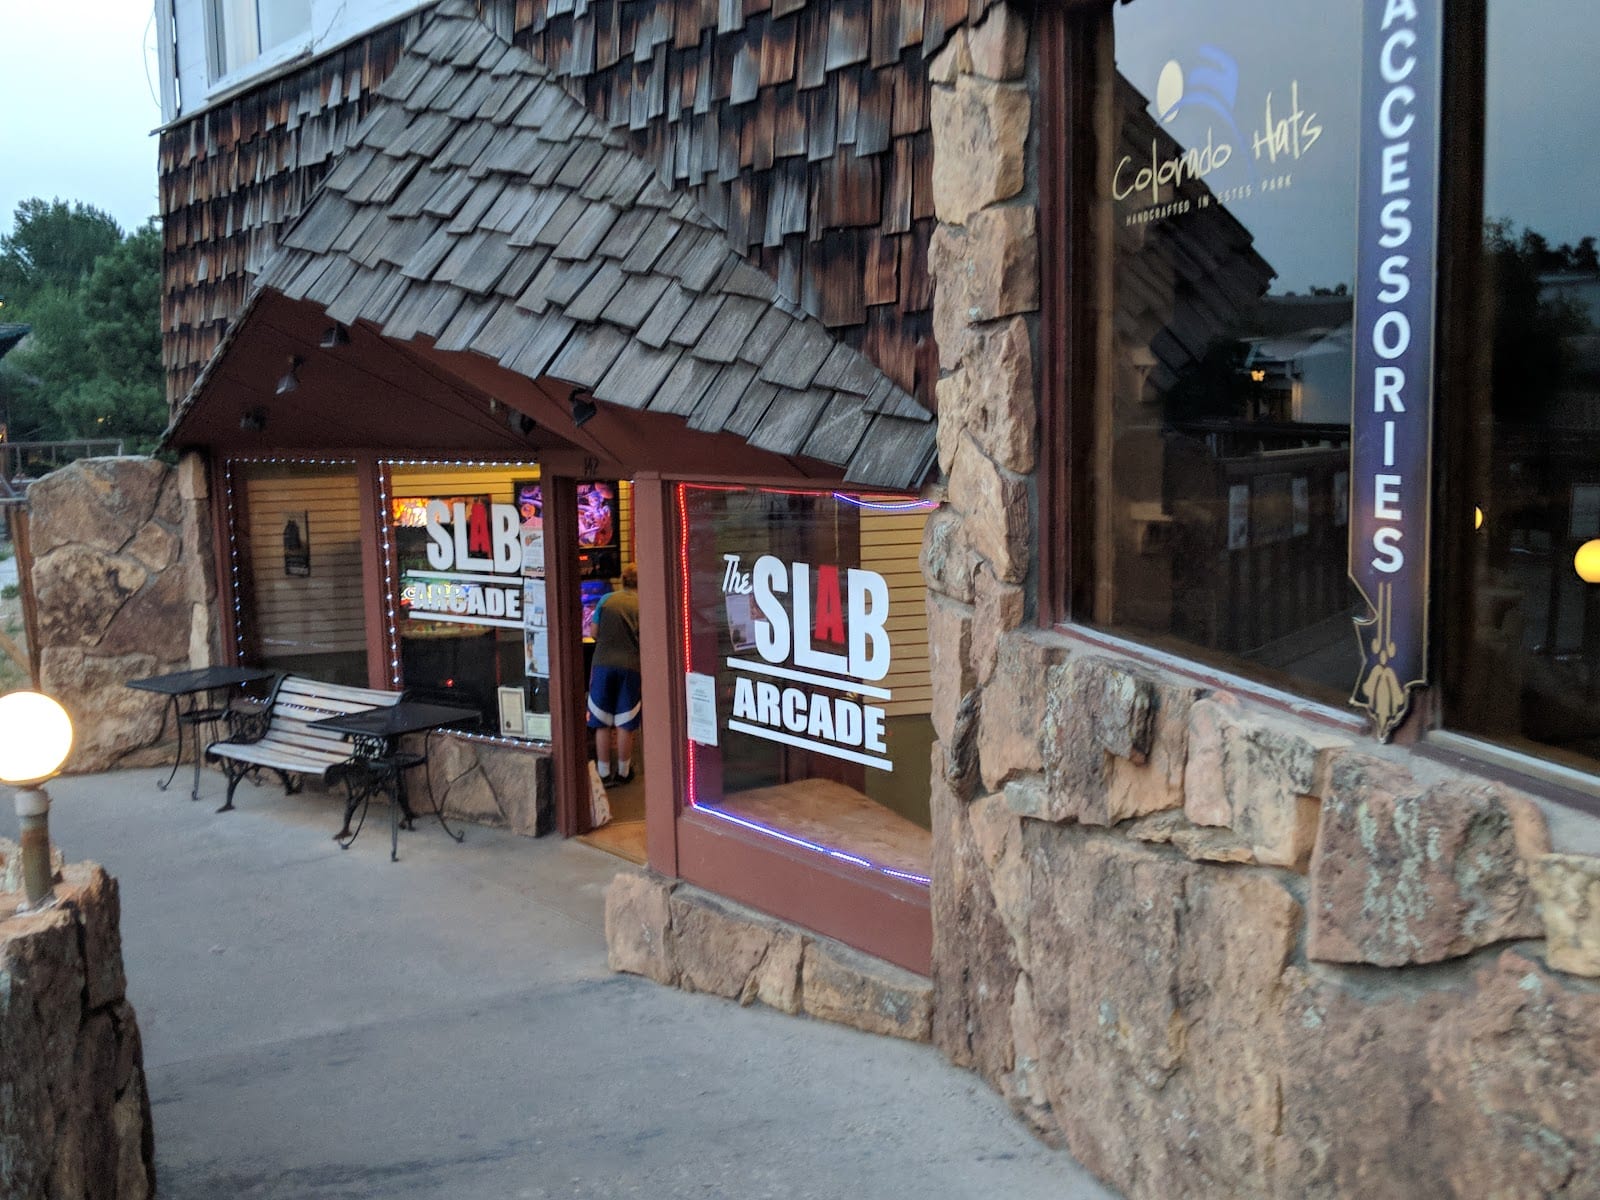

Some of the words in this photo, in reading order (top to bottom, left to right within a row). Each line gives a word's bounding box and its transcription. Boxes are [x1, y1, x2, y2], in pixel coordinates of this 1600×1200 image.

[1112, 126, 1232, 204] Colorado
[1252, 79, 1323, 163] Hats
[1126, 199, 1190, 226] HANDCRAFTED
[1197, 194, 1209, 209] IN
[1217, 184, 1251, 205] ESTES
[1261, 174, 1292, 193] PARK
[1371, 0, 1417, 573] ACCESSORIES
[427, 499, 521, 573] SLAB
[413, 581, 521, 618] ARCADE
[722, 554, 753, 594] The
[753, 555, 891, 681] SLAB
[733, 676, 886, 753] ARCADE
